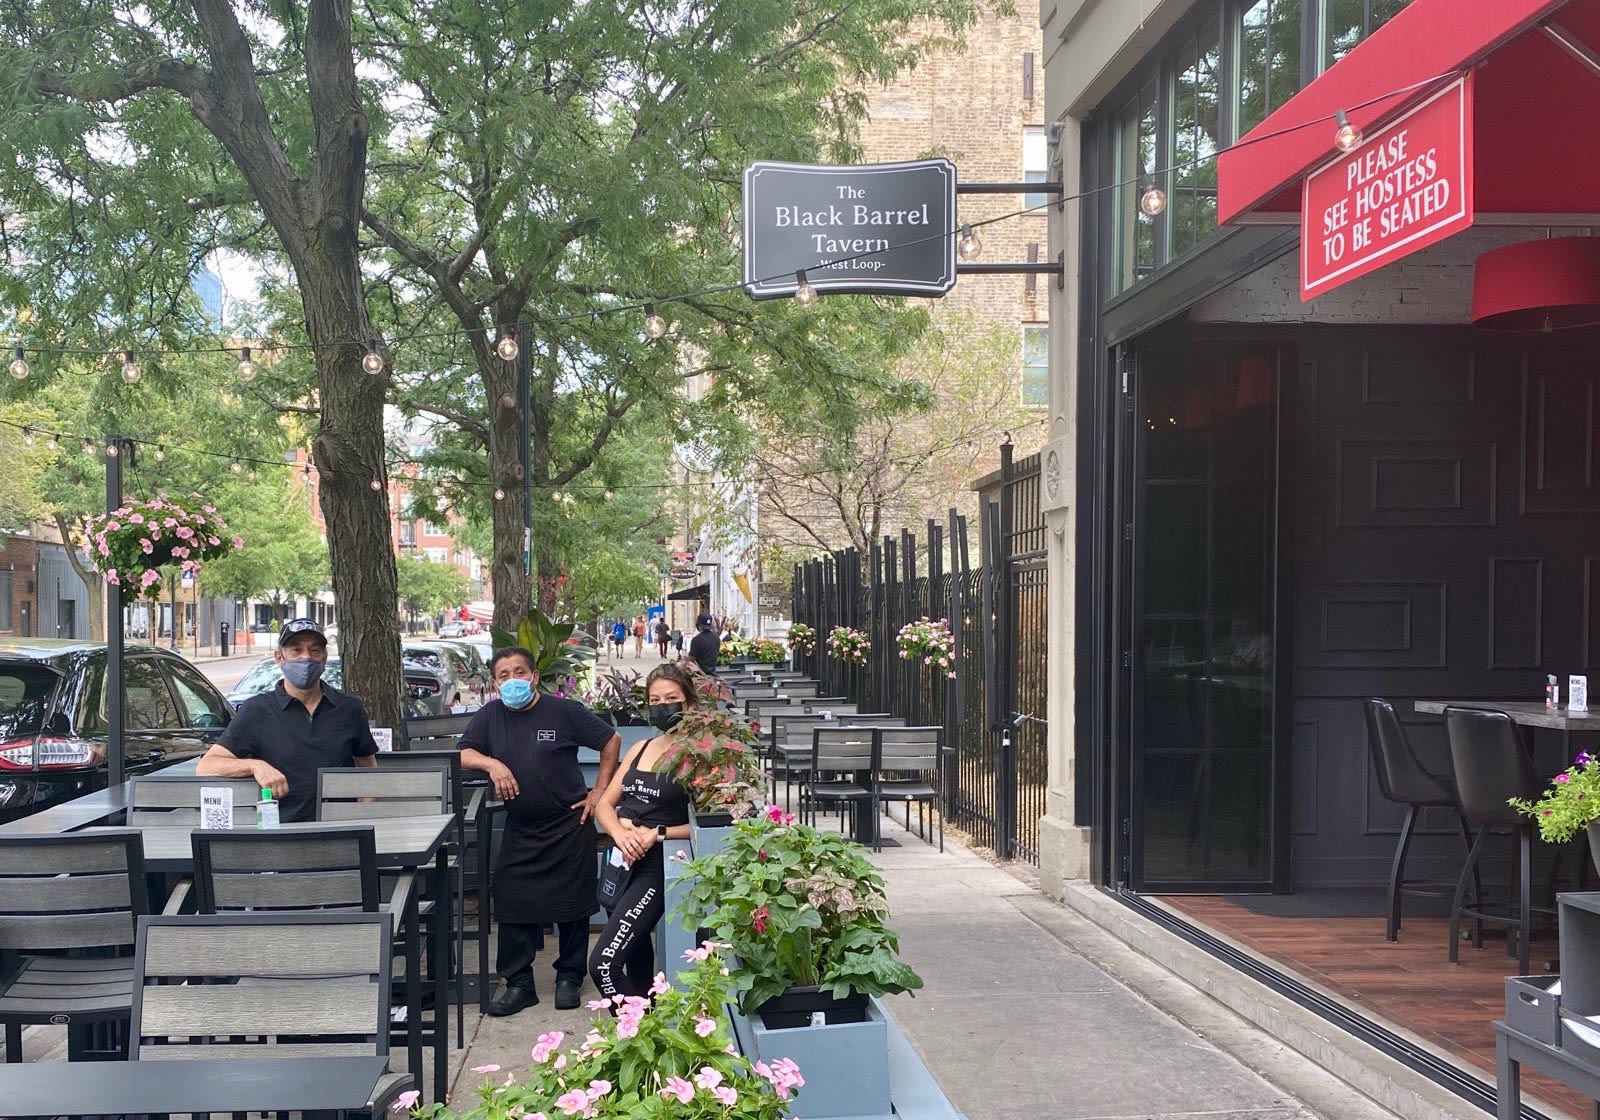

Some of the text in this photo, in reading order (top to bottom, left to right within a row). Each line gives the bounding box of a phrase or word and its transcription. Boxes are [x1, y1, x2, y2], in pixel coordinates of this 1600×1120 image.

[1347, 129, 1408, 191] PLEASE
[836, 185, 866, 199] The
[1323, 147, 1437, 236] SEE HOSTESS
[775, 203, 930, 227] Black Barrel
[1322, 178, 1450, 265] TO BE SEATED
[811, 234, 889, 253] Tavern
[203, 797, 222, 805] MENU
[637, 785, 660, 798] Barrel
[625, 887, 656, 920] Tavern
[601, 919, 632, 958] Barrel
[597, 961, 616, 995] Black
